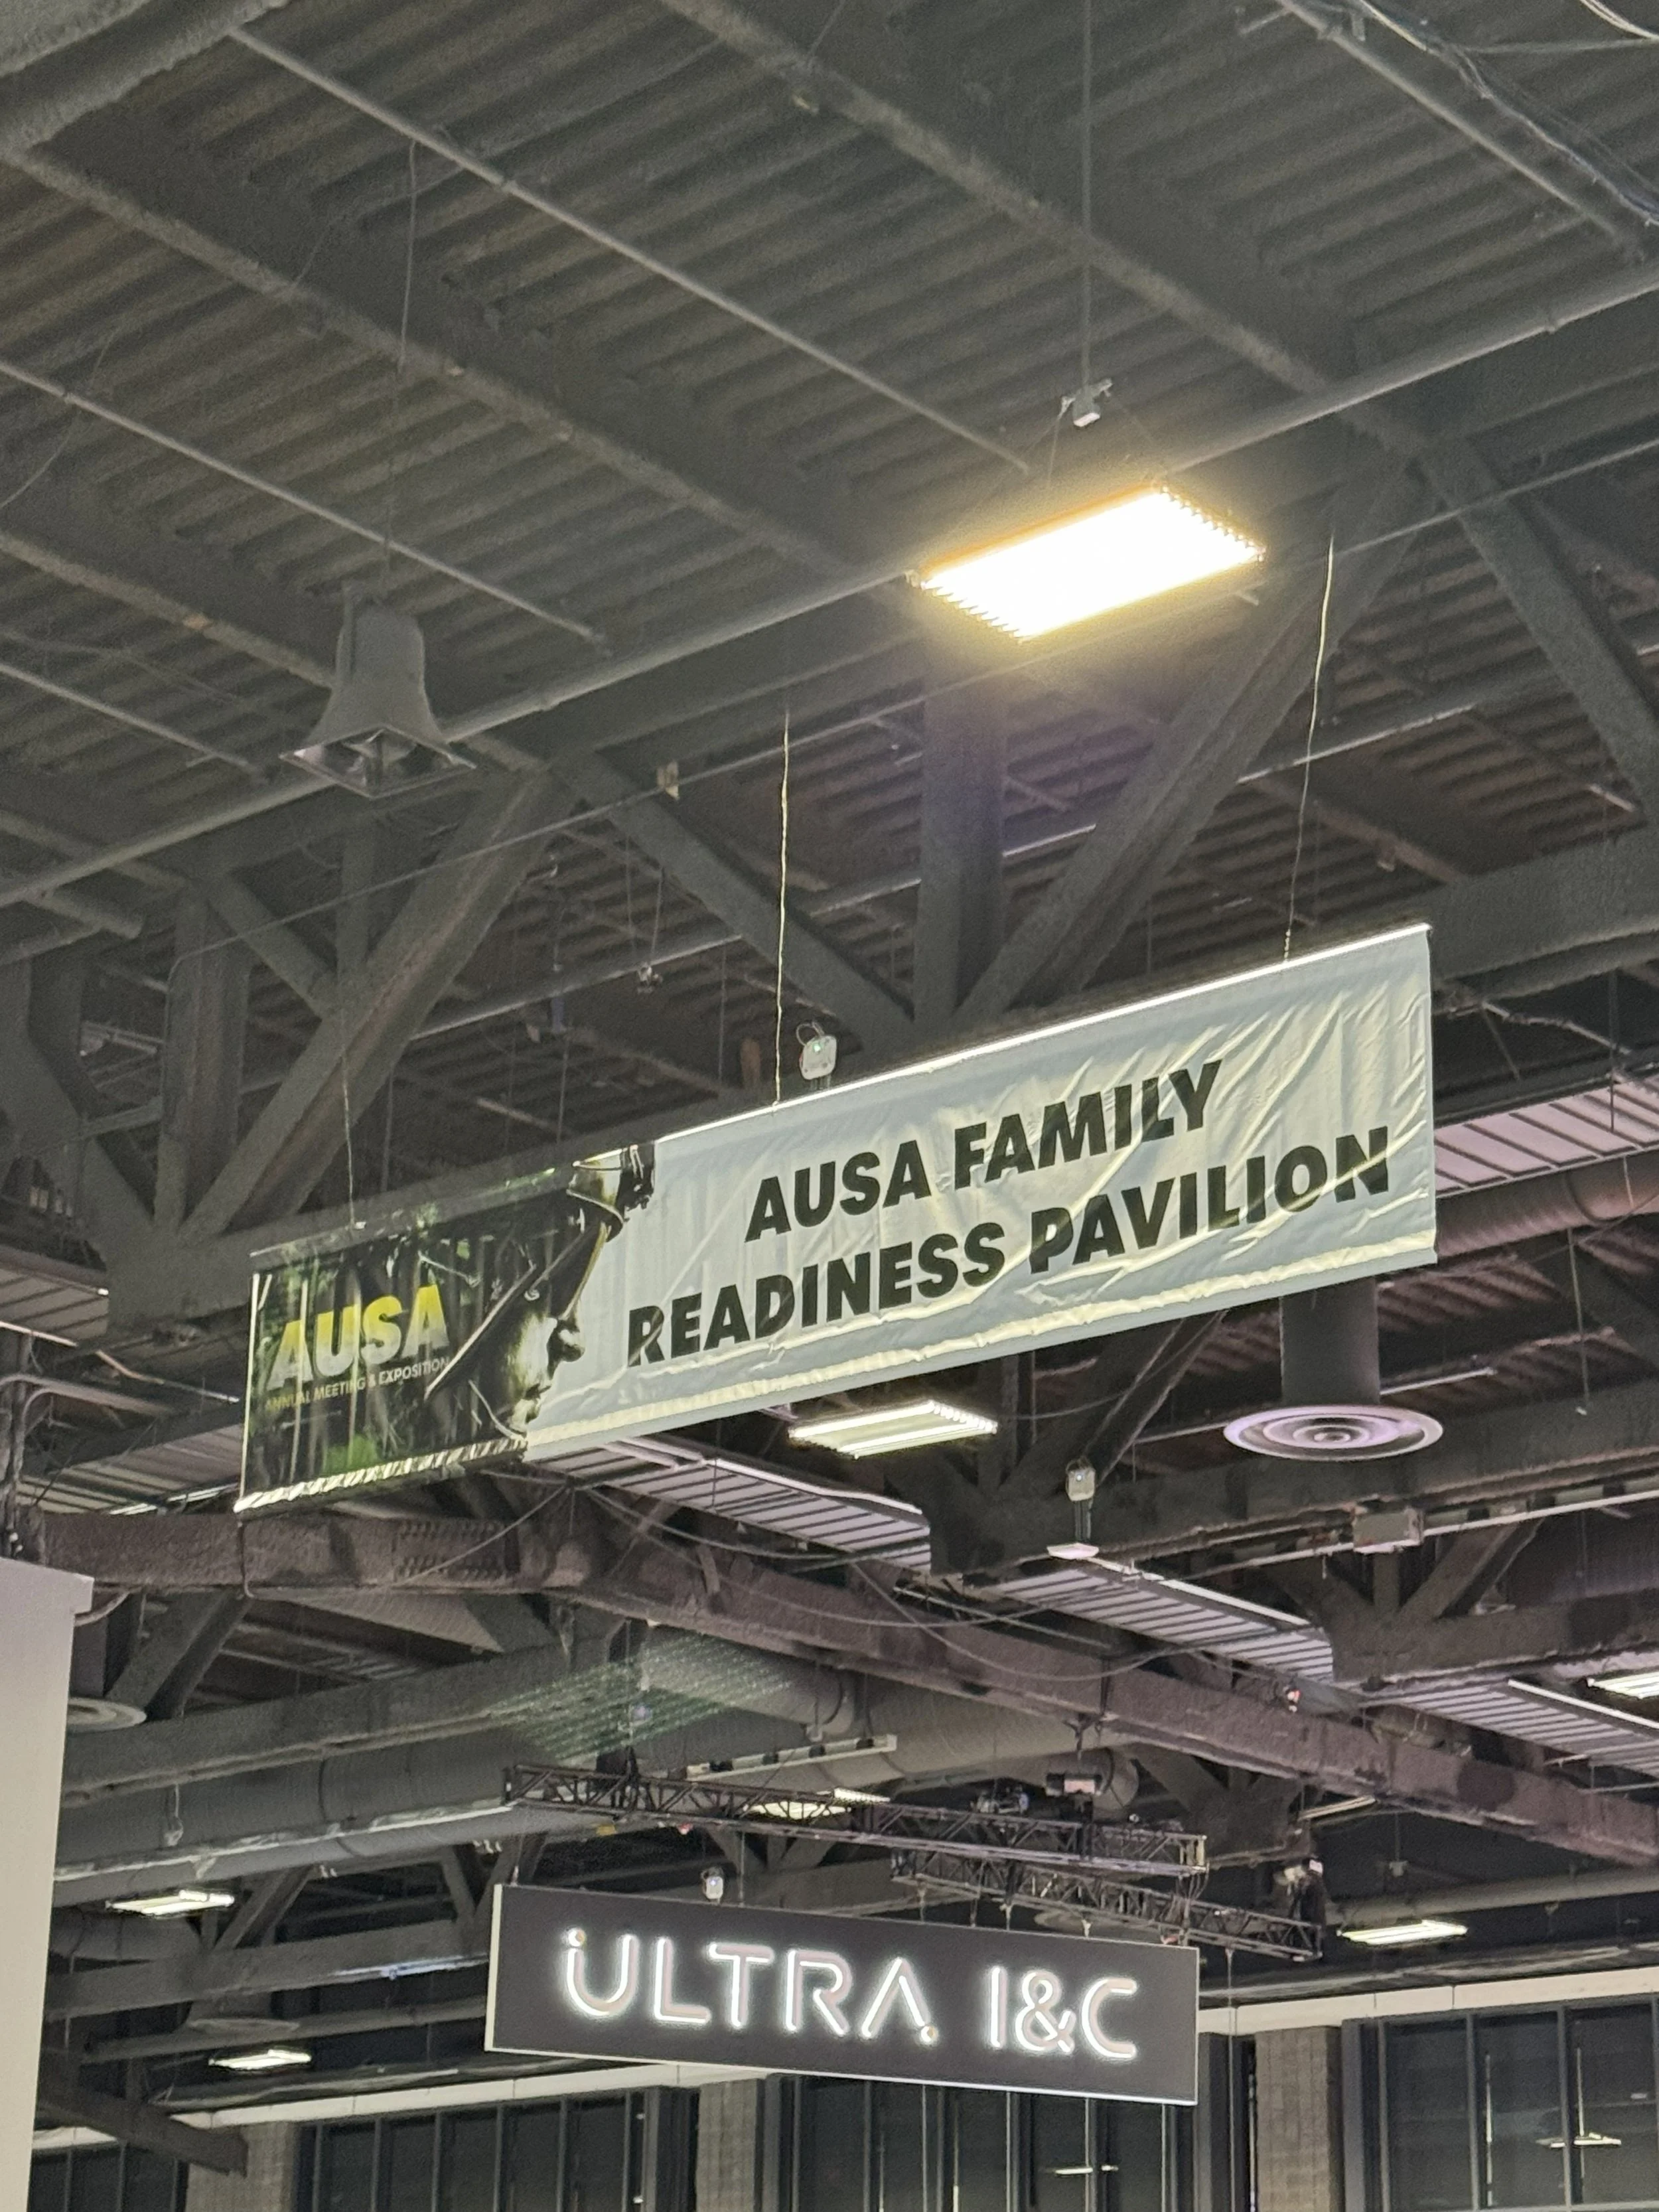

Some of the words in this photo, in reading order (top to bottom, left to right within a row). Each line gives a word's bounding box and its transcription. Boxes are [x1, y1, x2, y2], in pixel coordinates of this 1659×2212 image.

[745, 1140, 931, 1242] AUSA
[954, 1059, 1222, 1189] FAMILY
[627, 1222, 1005, 1367] READINESS
[1029, 1126, 1388, 1274] PAVILION
[267, 1284, 449, 1390] AUSA
[313, 1378, 366, 1402] MEETING
[378, 1357, 451, 1385] EXPOSITION
[564, 1927, 938, 2043] ULTRA
[987, 1963, 1139, 2061] I&C
